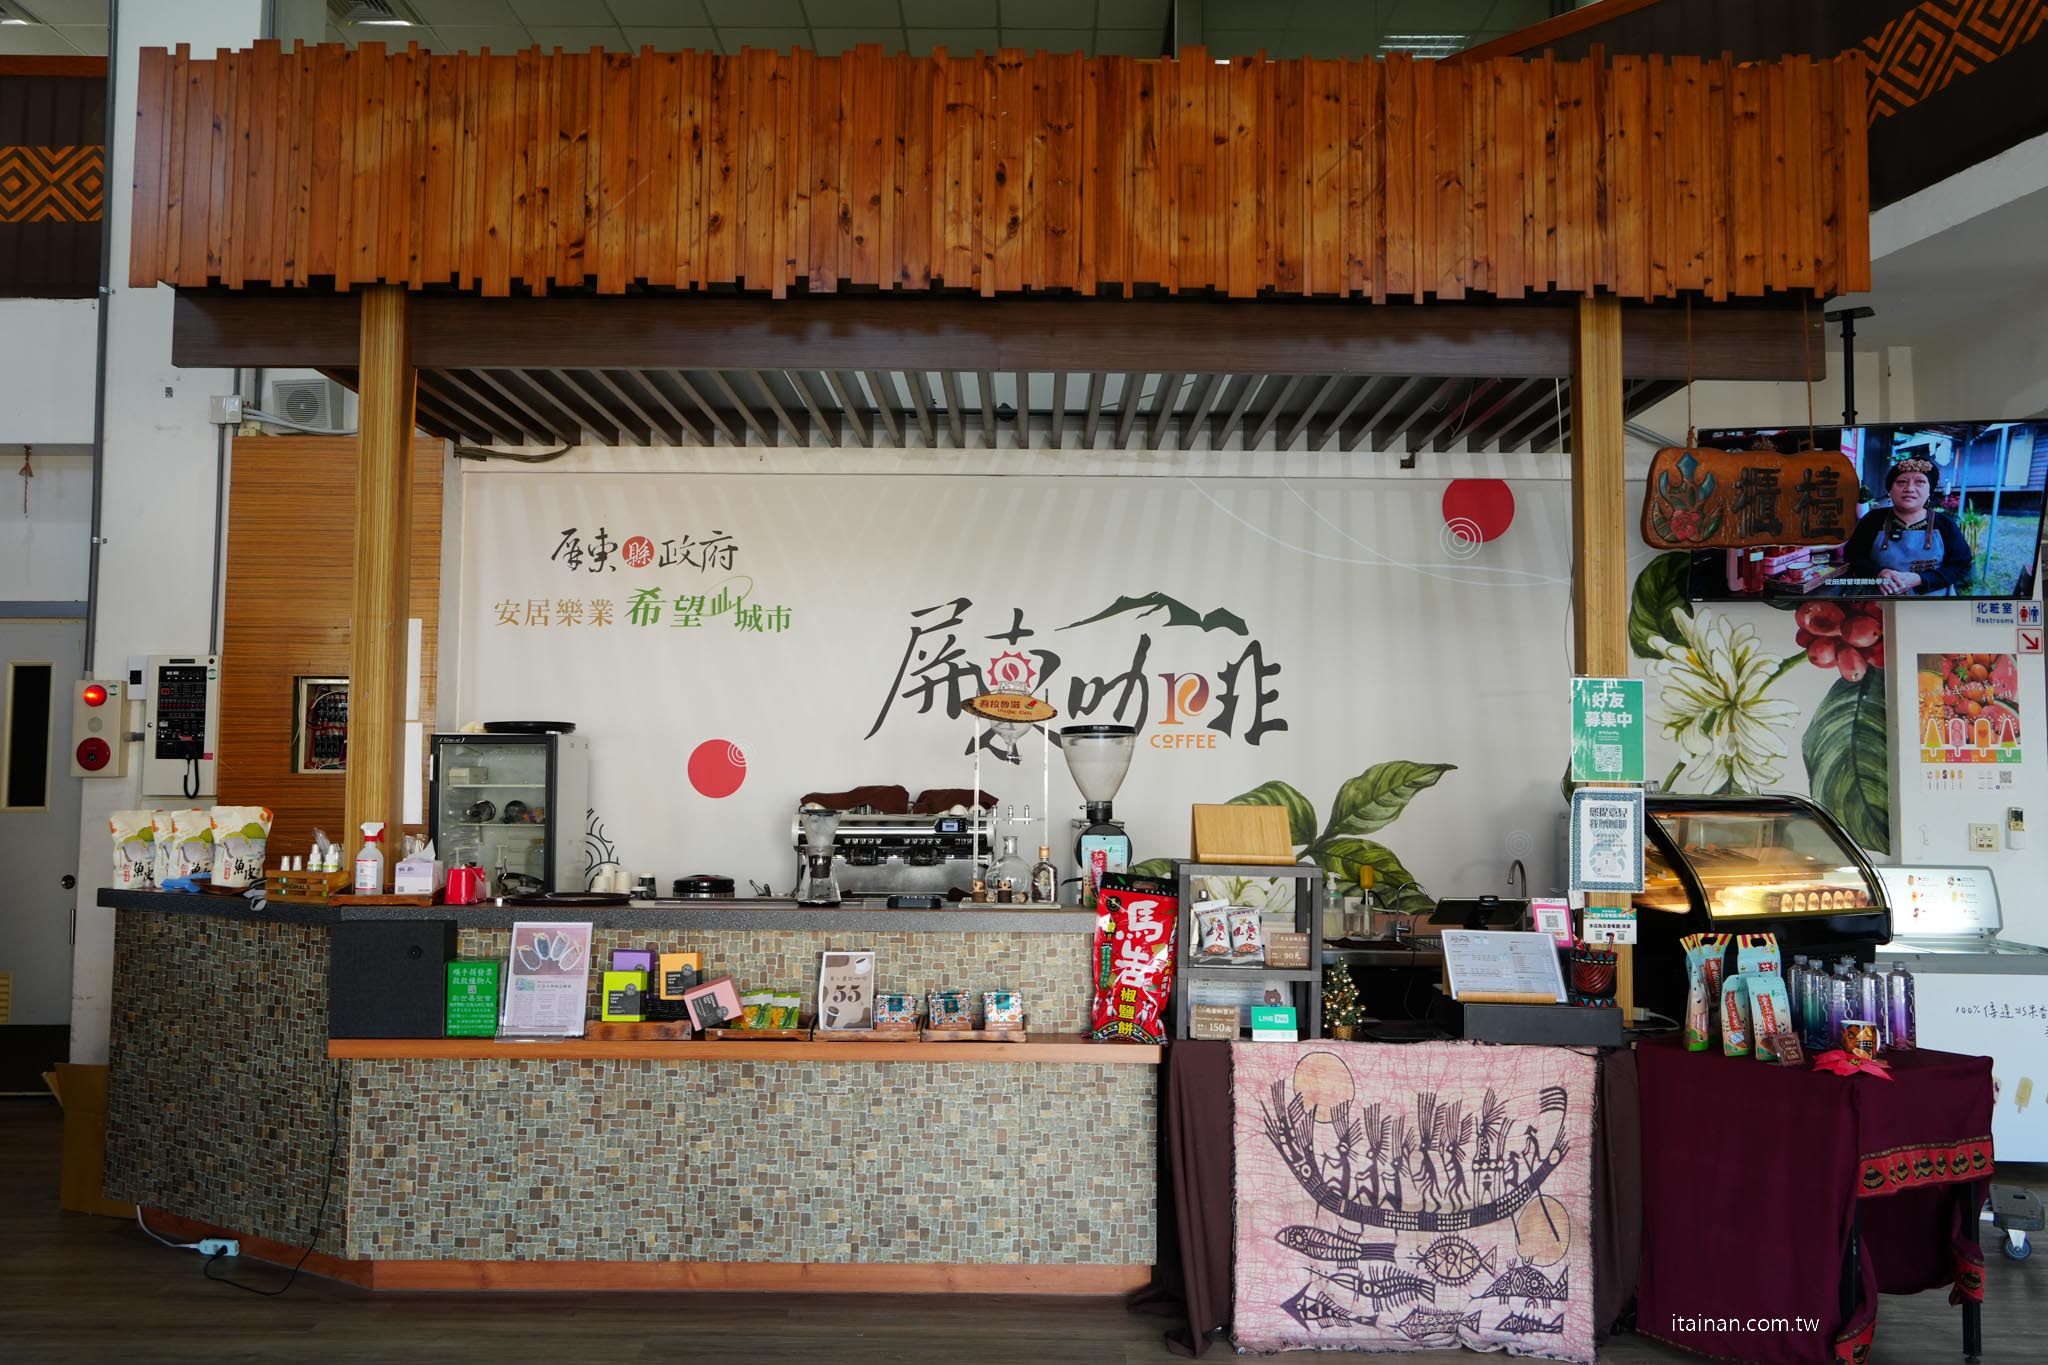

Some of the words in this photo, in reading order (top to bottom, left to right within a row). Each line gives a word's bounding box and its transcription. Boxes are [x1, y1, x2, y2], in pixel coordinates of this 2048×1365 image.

[551, 527, 738, 573] 屏東縣政府
[494, 598, 614, 627] 安居樂業
[1976, 602, 2013, 614] 化粧室
[1976, 616, 2014, 624] Restrooms
[1585, 711, 1633, 728] 募集中
[1151, 734, 1217, 749] COFFEE
[234, 857, 259, 880] 魚皮
[1115, 900, 1164, 988] 馬告
[832, 985, 862, 1003] 55
[1118, 987, 1138, 1036] 椒鹽餅
